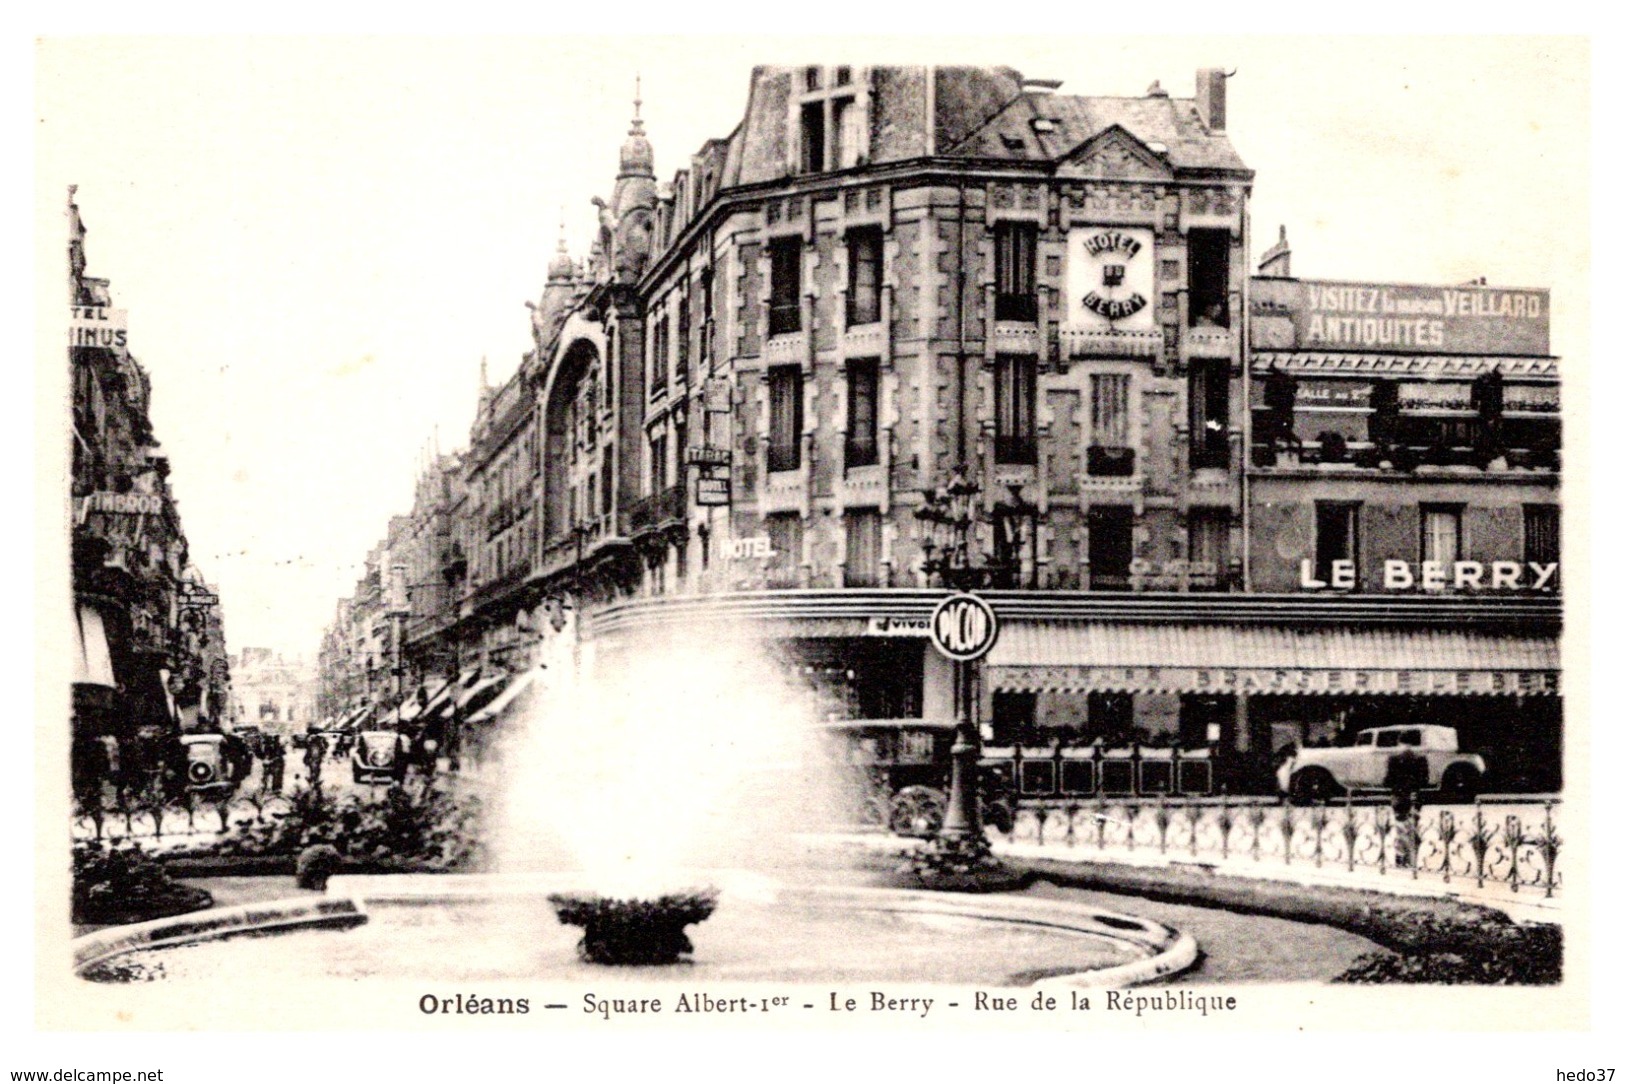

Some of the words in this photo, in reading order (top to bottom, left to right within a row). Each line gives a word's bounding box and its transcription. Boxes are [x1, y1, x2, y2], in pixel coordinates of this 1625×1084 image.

[1083, 232, 1142, 260] HOTEL
[1082, 290, 1147, 321] BERRY
[1308, 285, 1378, 312] VISITEZ
[1443, 290, 1540, 319] VEILLARD
[1301, 558, 1355, 588] LE
[1384, 560, 1558, 591] BERRY
